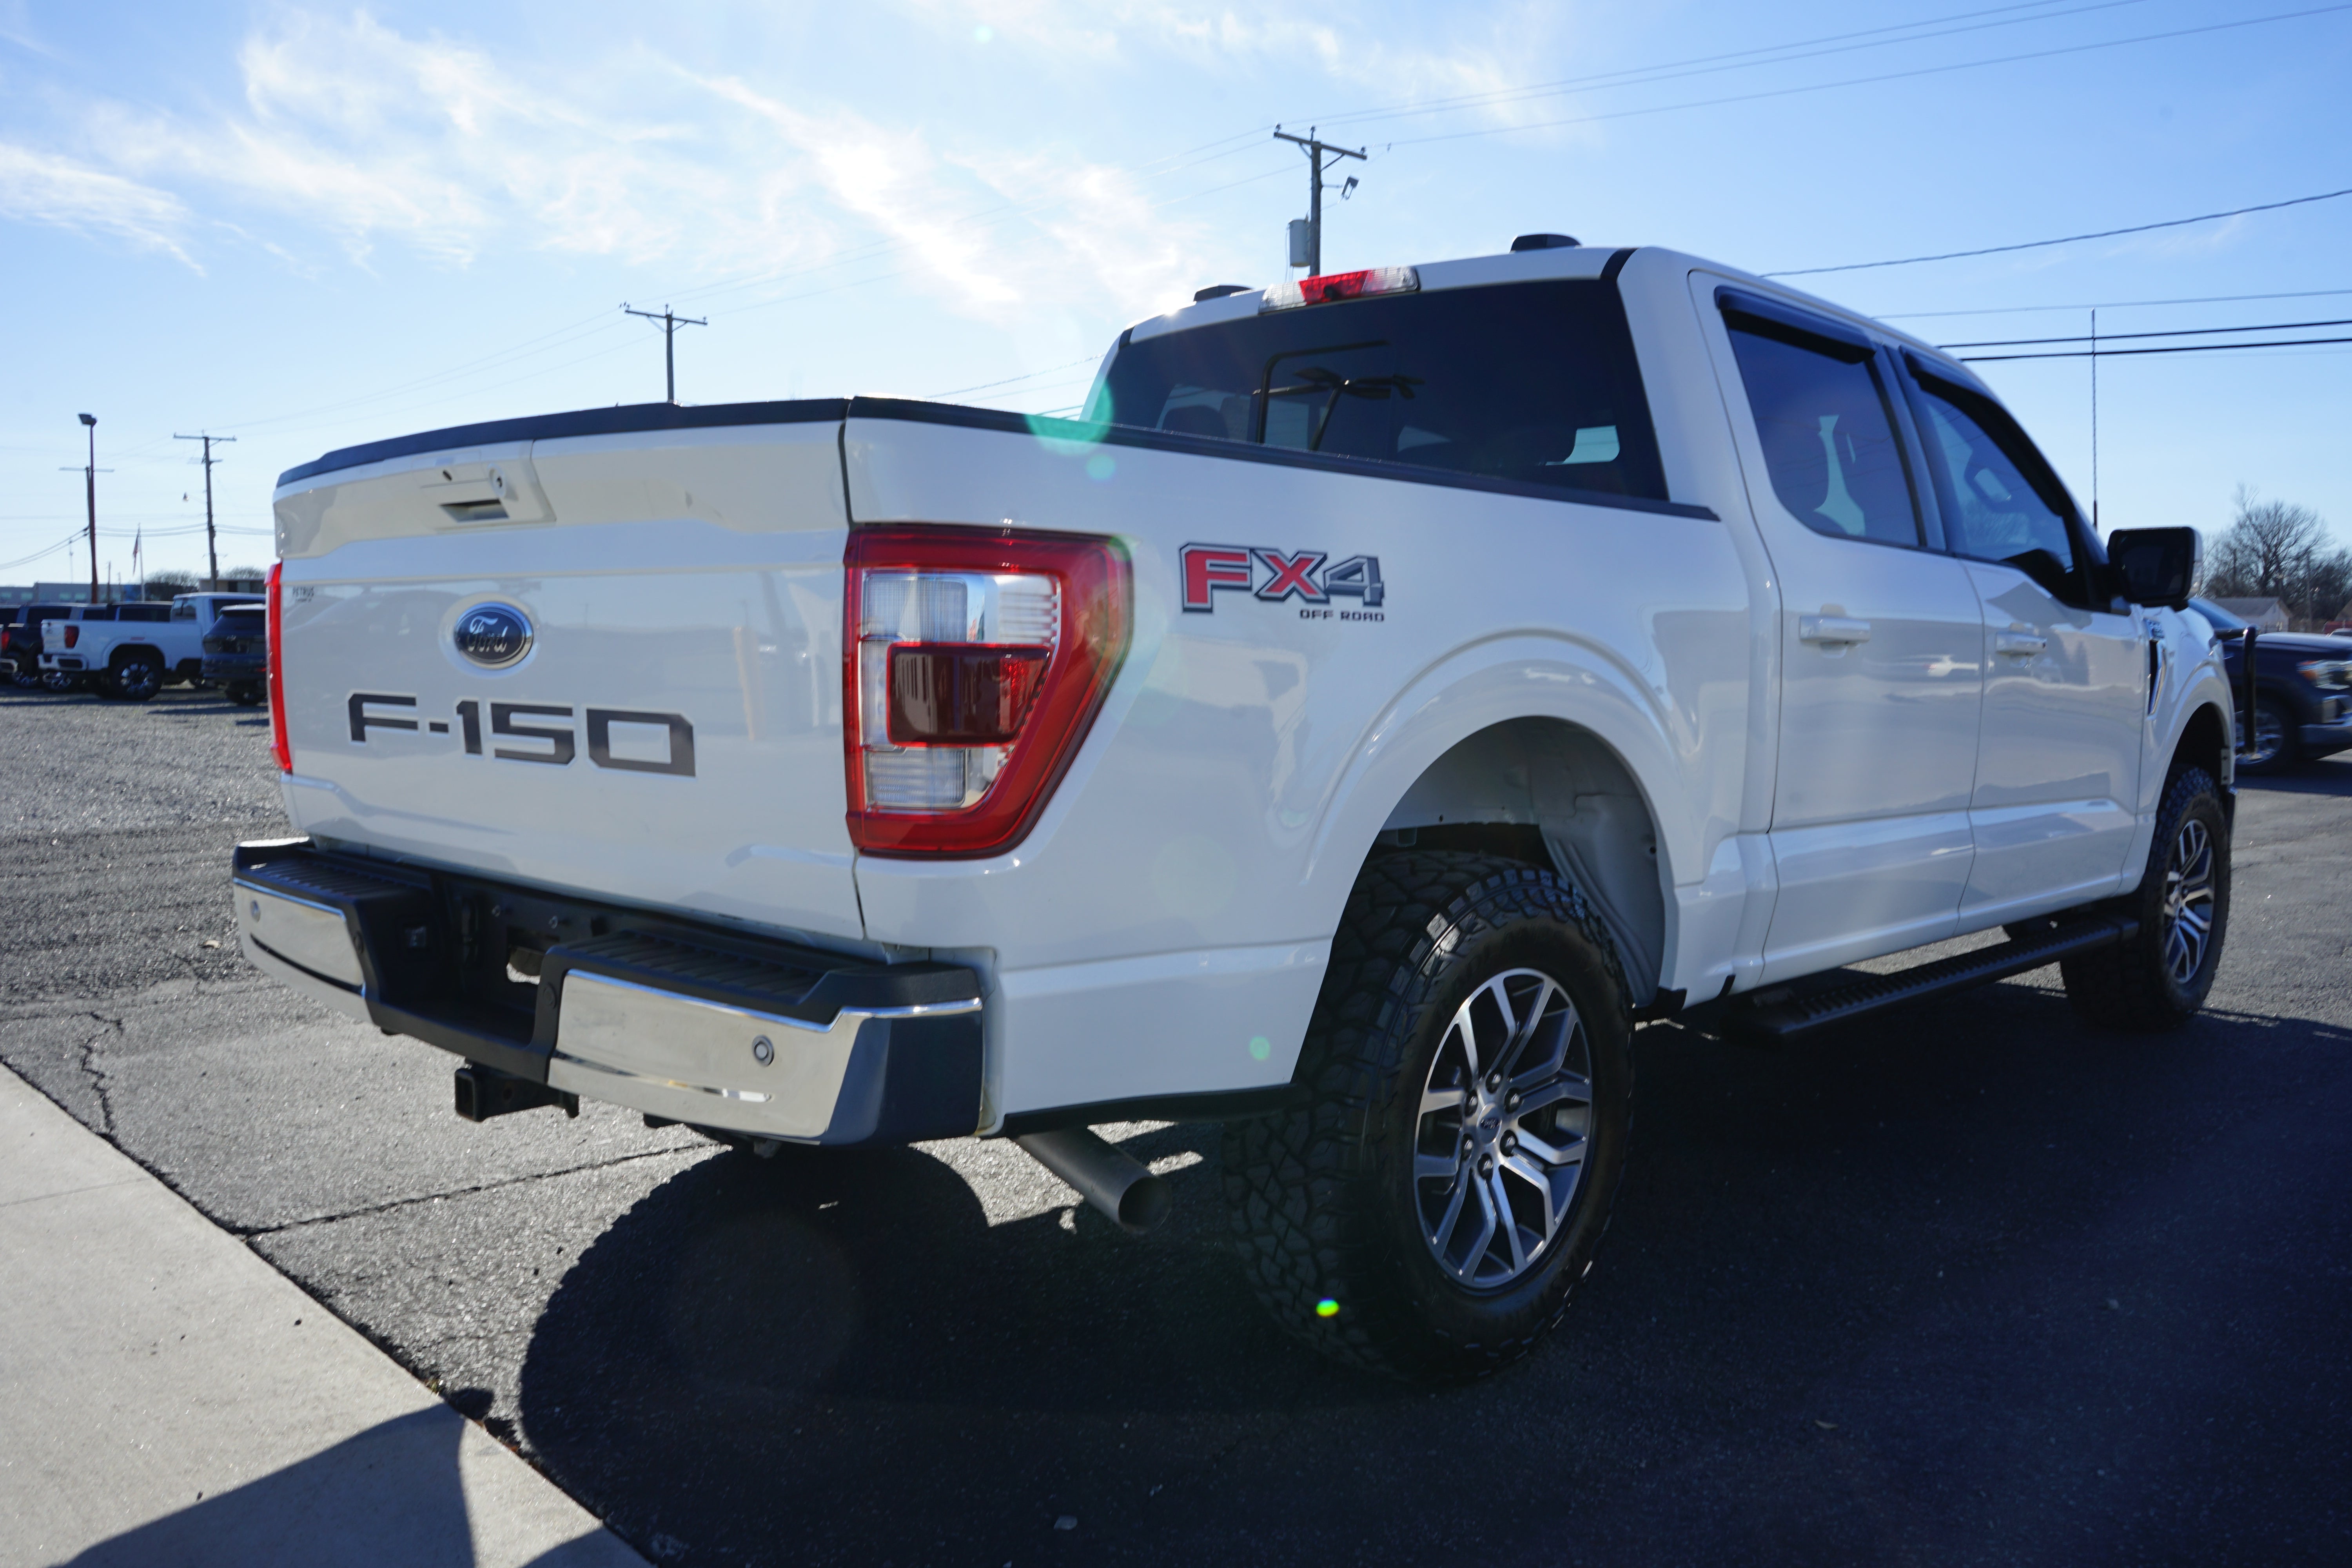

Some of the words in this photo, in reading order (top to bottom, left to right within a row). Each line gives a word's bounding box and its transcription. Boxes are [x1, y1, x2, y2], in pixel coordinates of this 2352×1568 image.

[1179, 542, 1385, 613] FX4
[467, 615, 509, 653] Ford
[1300, 609, 1334, 620] OFF
[1340, 610, 1385, 621] ROAD
[348, 693, 696, 777] F-150
